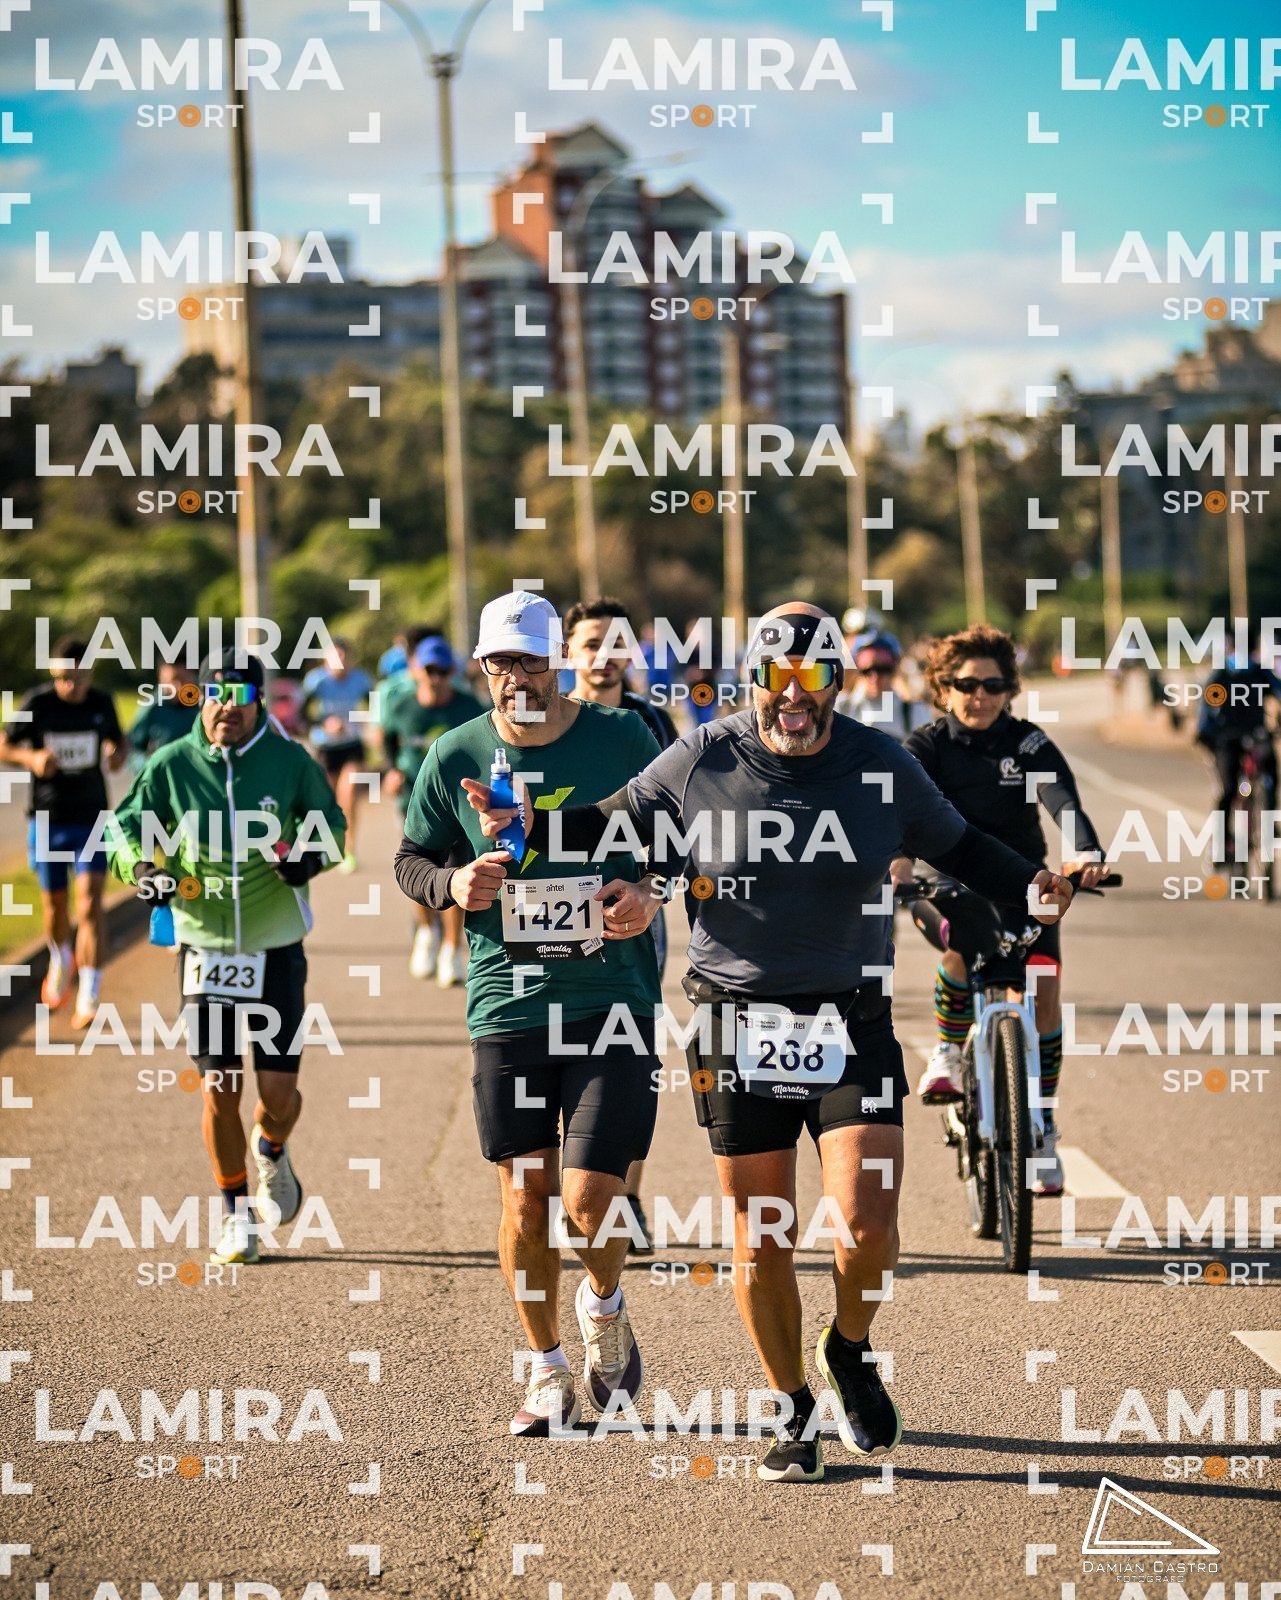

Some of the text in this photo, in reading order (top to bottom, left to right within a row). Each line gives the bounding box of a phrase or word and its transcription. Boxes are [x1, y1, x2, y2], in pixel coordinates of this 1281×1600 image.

[511, 899, 591, 931] 1421
[536, 944, 572, 954] Maratón
[192, 964, 255, 989] 1423
[756, 1039, 824, 1072] 268
[772, 1084, 809, 1095] Maratón
